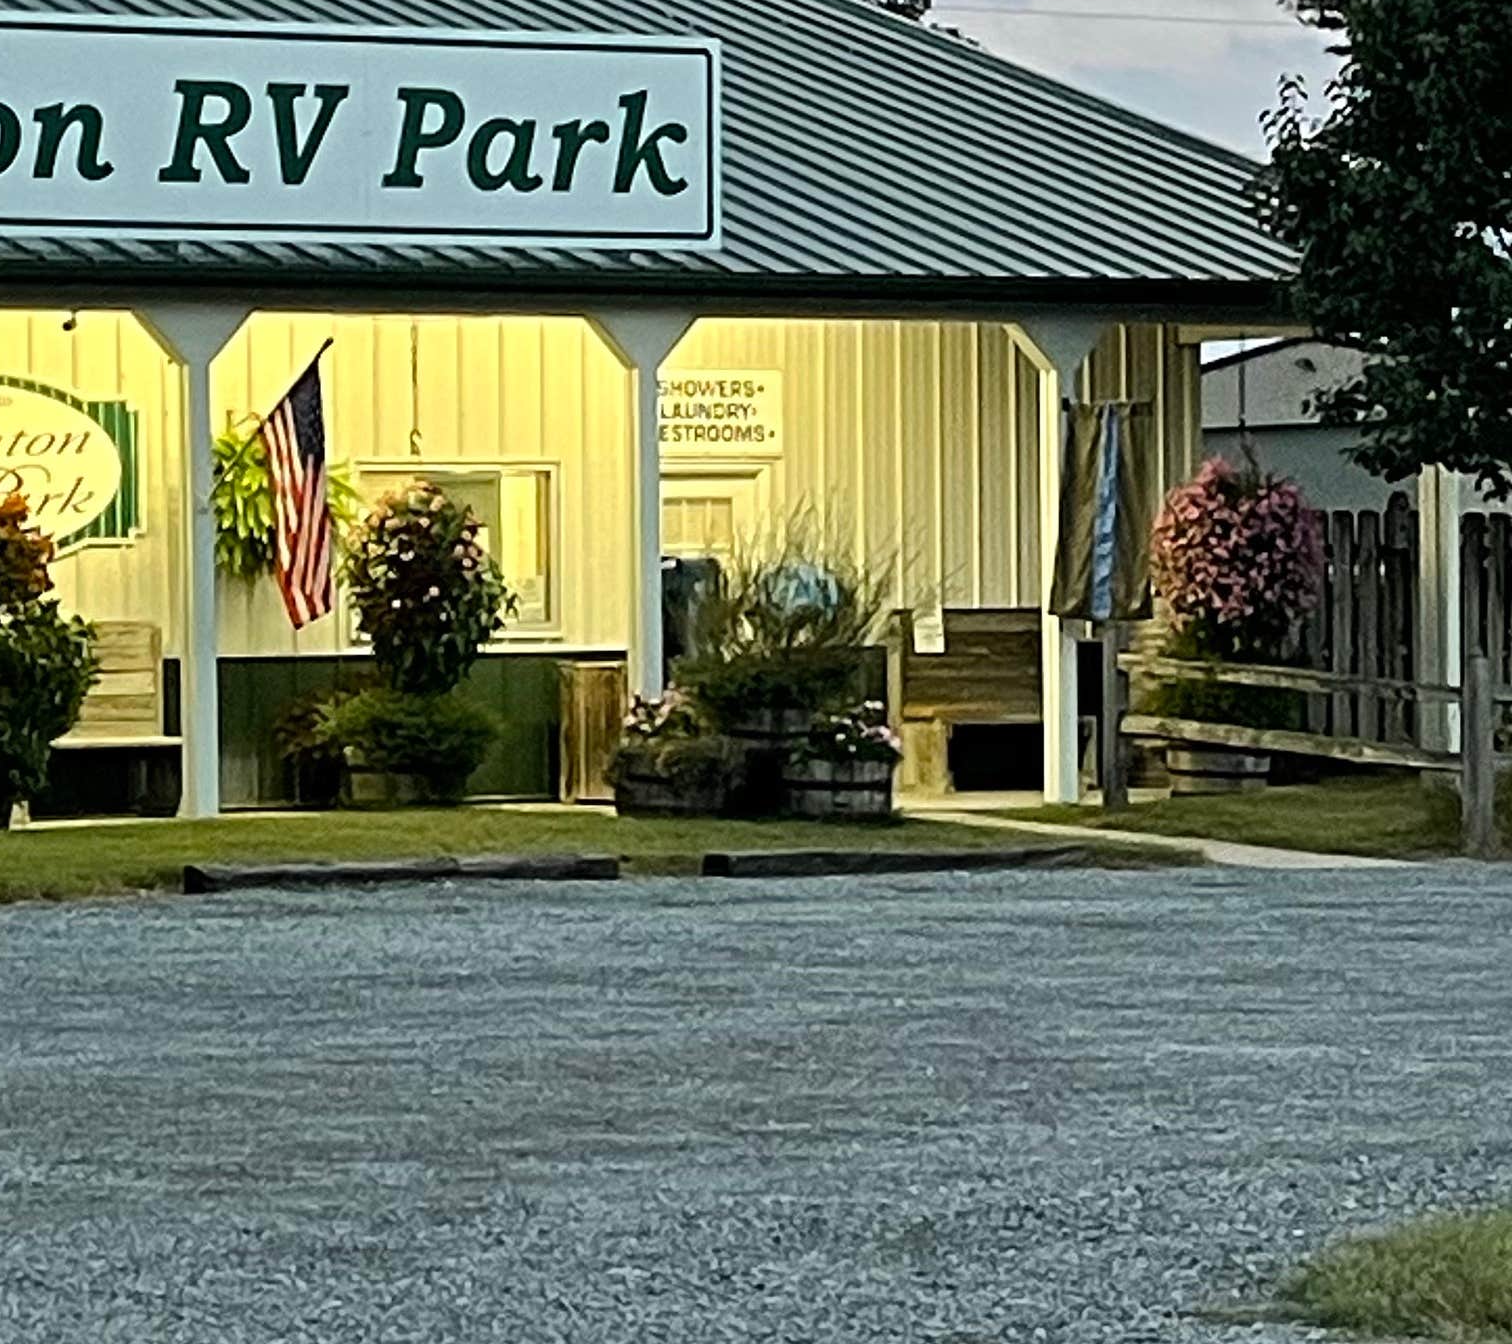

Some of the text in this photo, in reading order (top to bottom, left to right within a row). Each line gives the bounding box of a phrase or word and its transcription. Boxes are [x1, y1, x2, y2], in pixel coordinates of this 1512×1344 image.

[158, 79, 350, 185] RV
[381, 87, 689, 196] Park
[657, 379, 756, 399] SHOWERS
[660, 402, 753, 420] LAUNDRY
[658, 424, 765, 442] ESTROOMS
